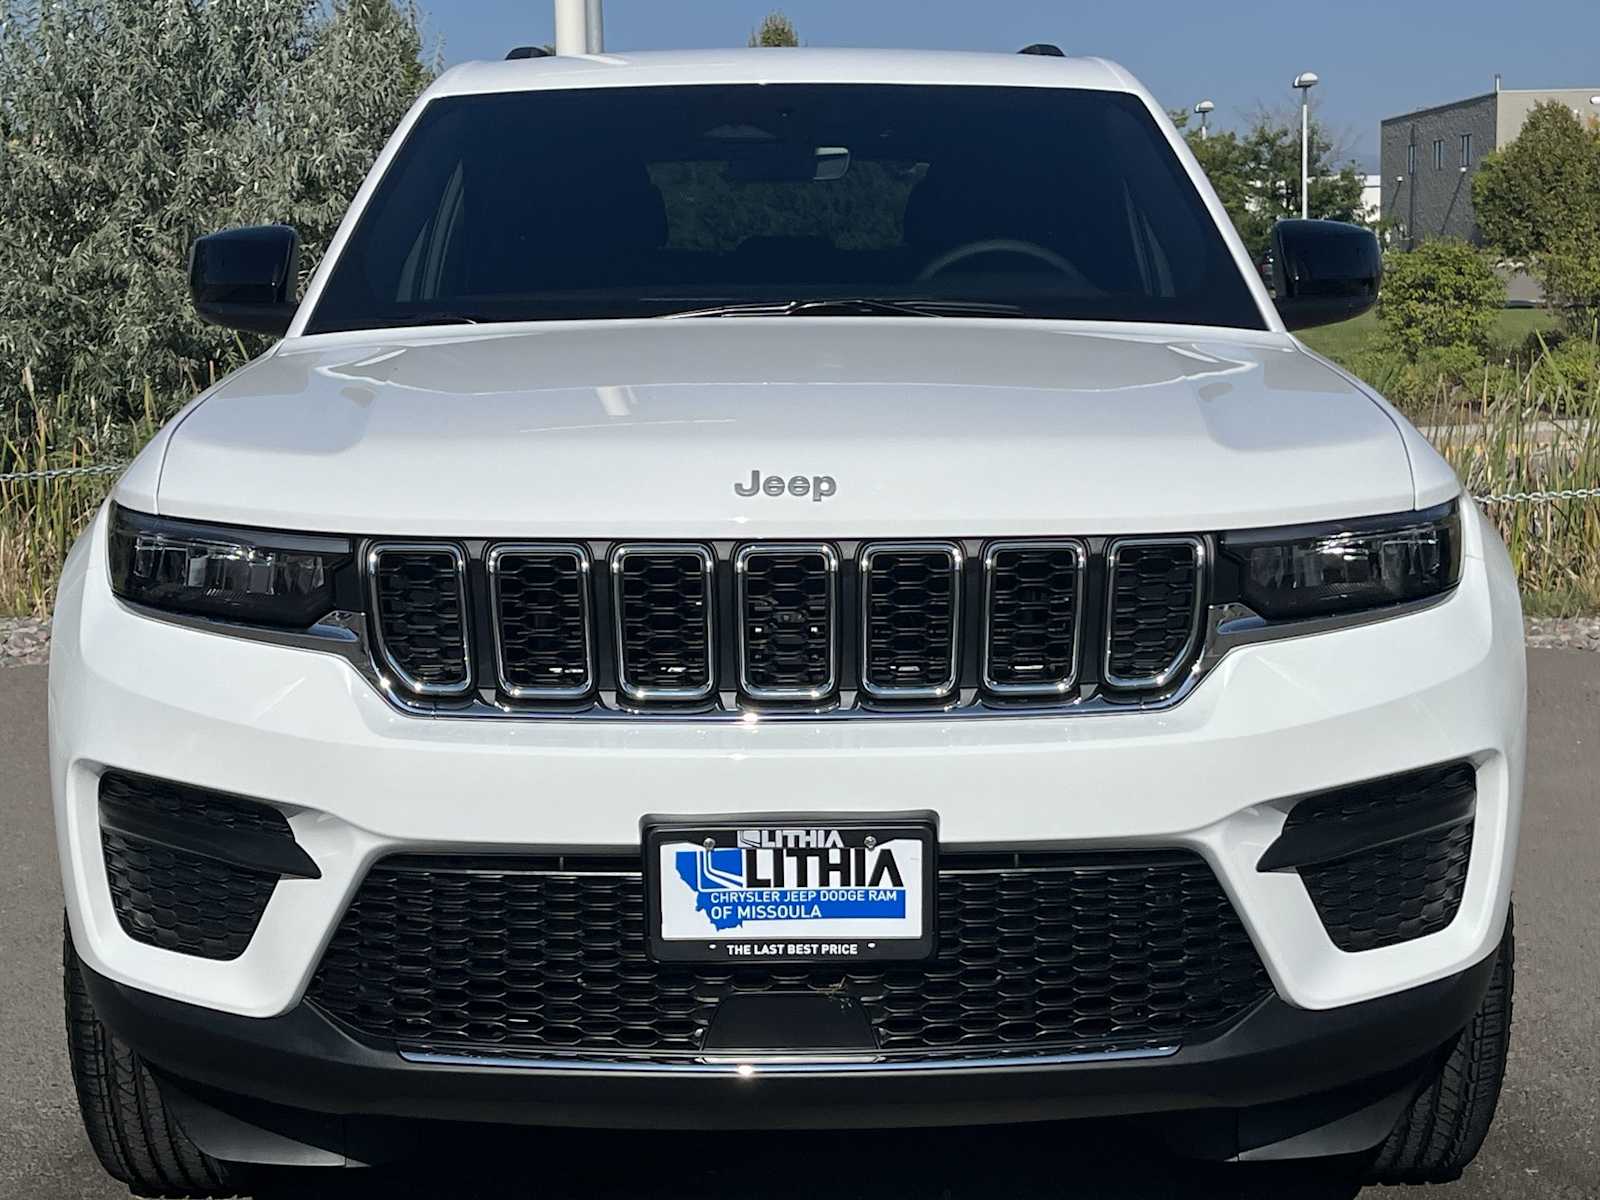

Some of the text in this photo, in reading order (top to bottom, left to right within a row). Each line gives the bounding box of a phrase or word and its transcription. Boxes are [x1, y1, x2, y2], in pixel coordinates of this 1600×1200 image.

[734, 470, 837, 502] Jeep
[760, 830, 845, 848] LITHIA
[746, 849, 905, 888] LITHIA
[710, 890, 897, 903] CHRYSLER JEEP DODGE RAM
[711, 906, 822, 920] OF MISSOULA
[726, 943, 858, 955] THE LAST BEST PRICE
